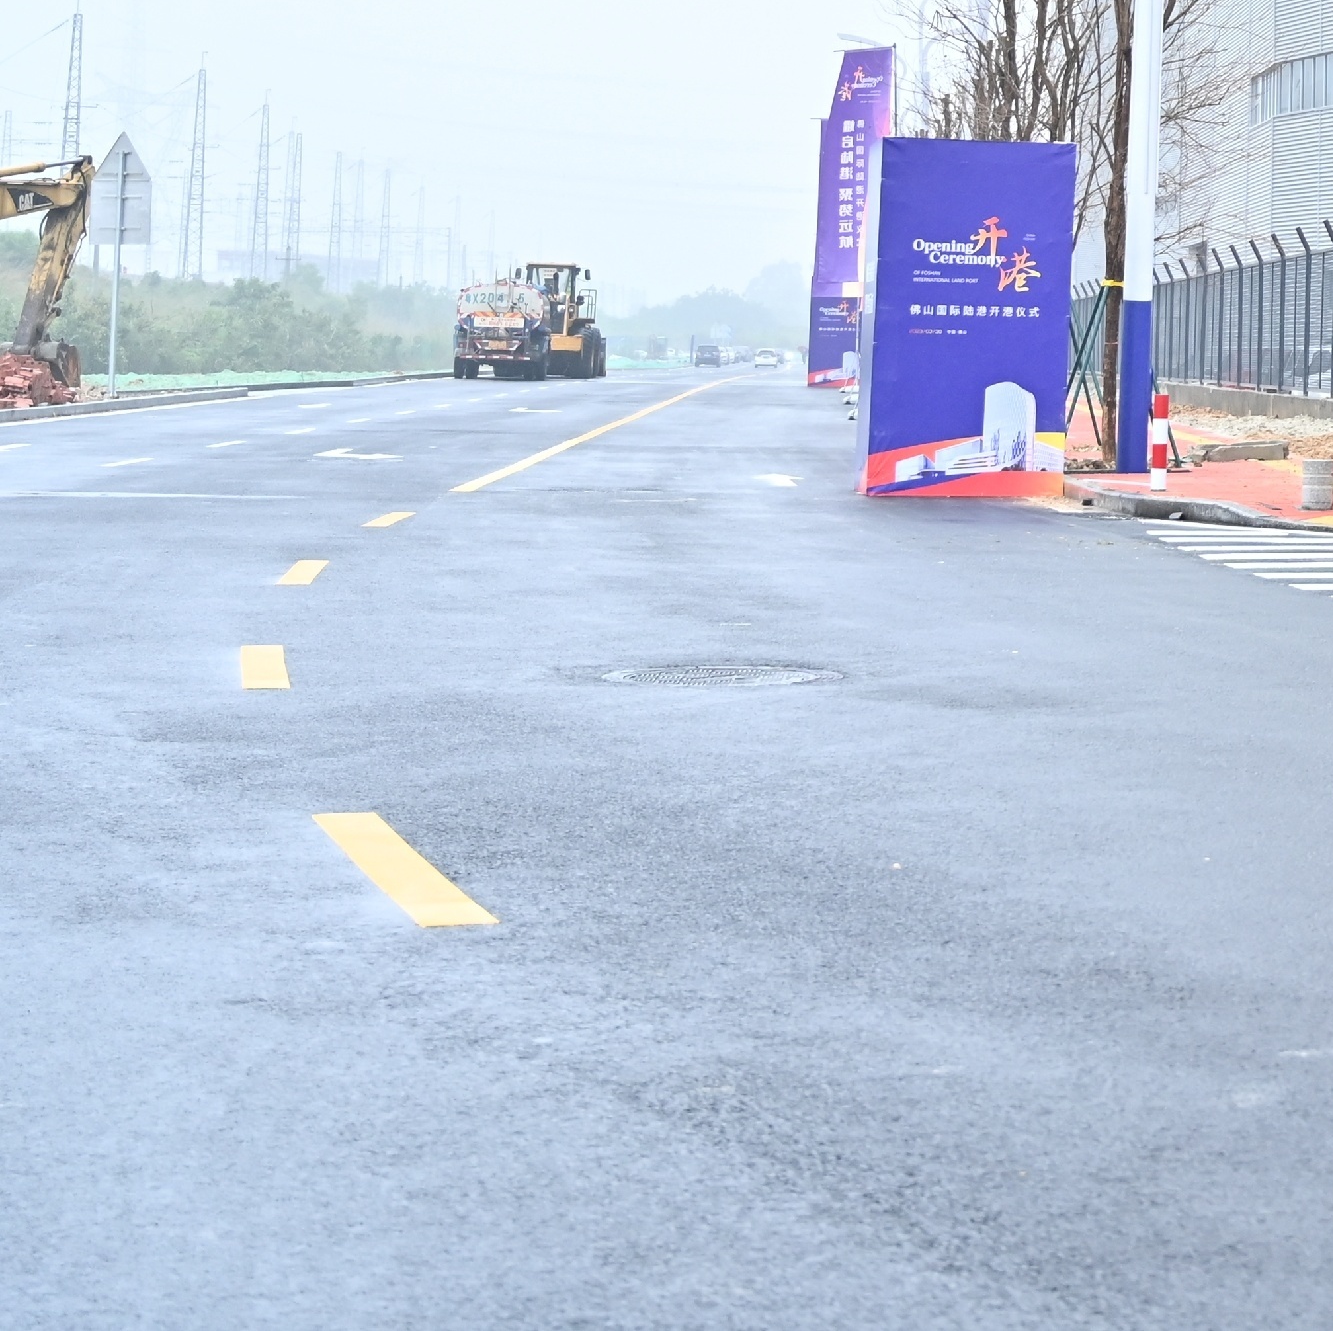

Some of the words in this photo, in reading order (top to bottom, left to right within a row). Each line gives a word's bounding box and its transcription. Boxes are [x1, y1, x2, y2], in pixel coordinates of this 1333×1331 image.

[19, 192, 35, 211] CAT
[912, 238, 975, 255] Opening
[929, 251, 1007, 268] Ceremony
[909, 304, 1041, 318] 佛山国际陆港开港仪式
